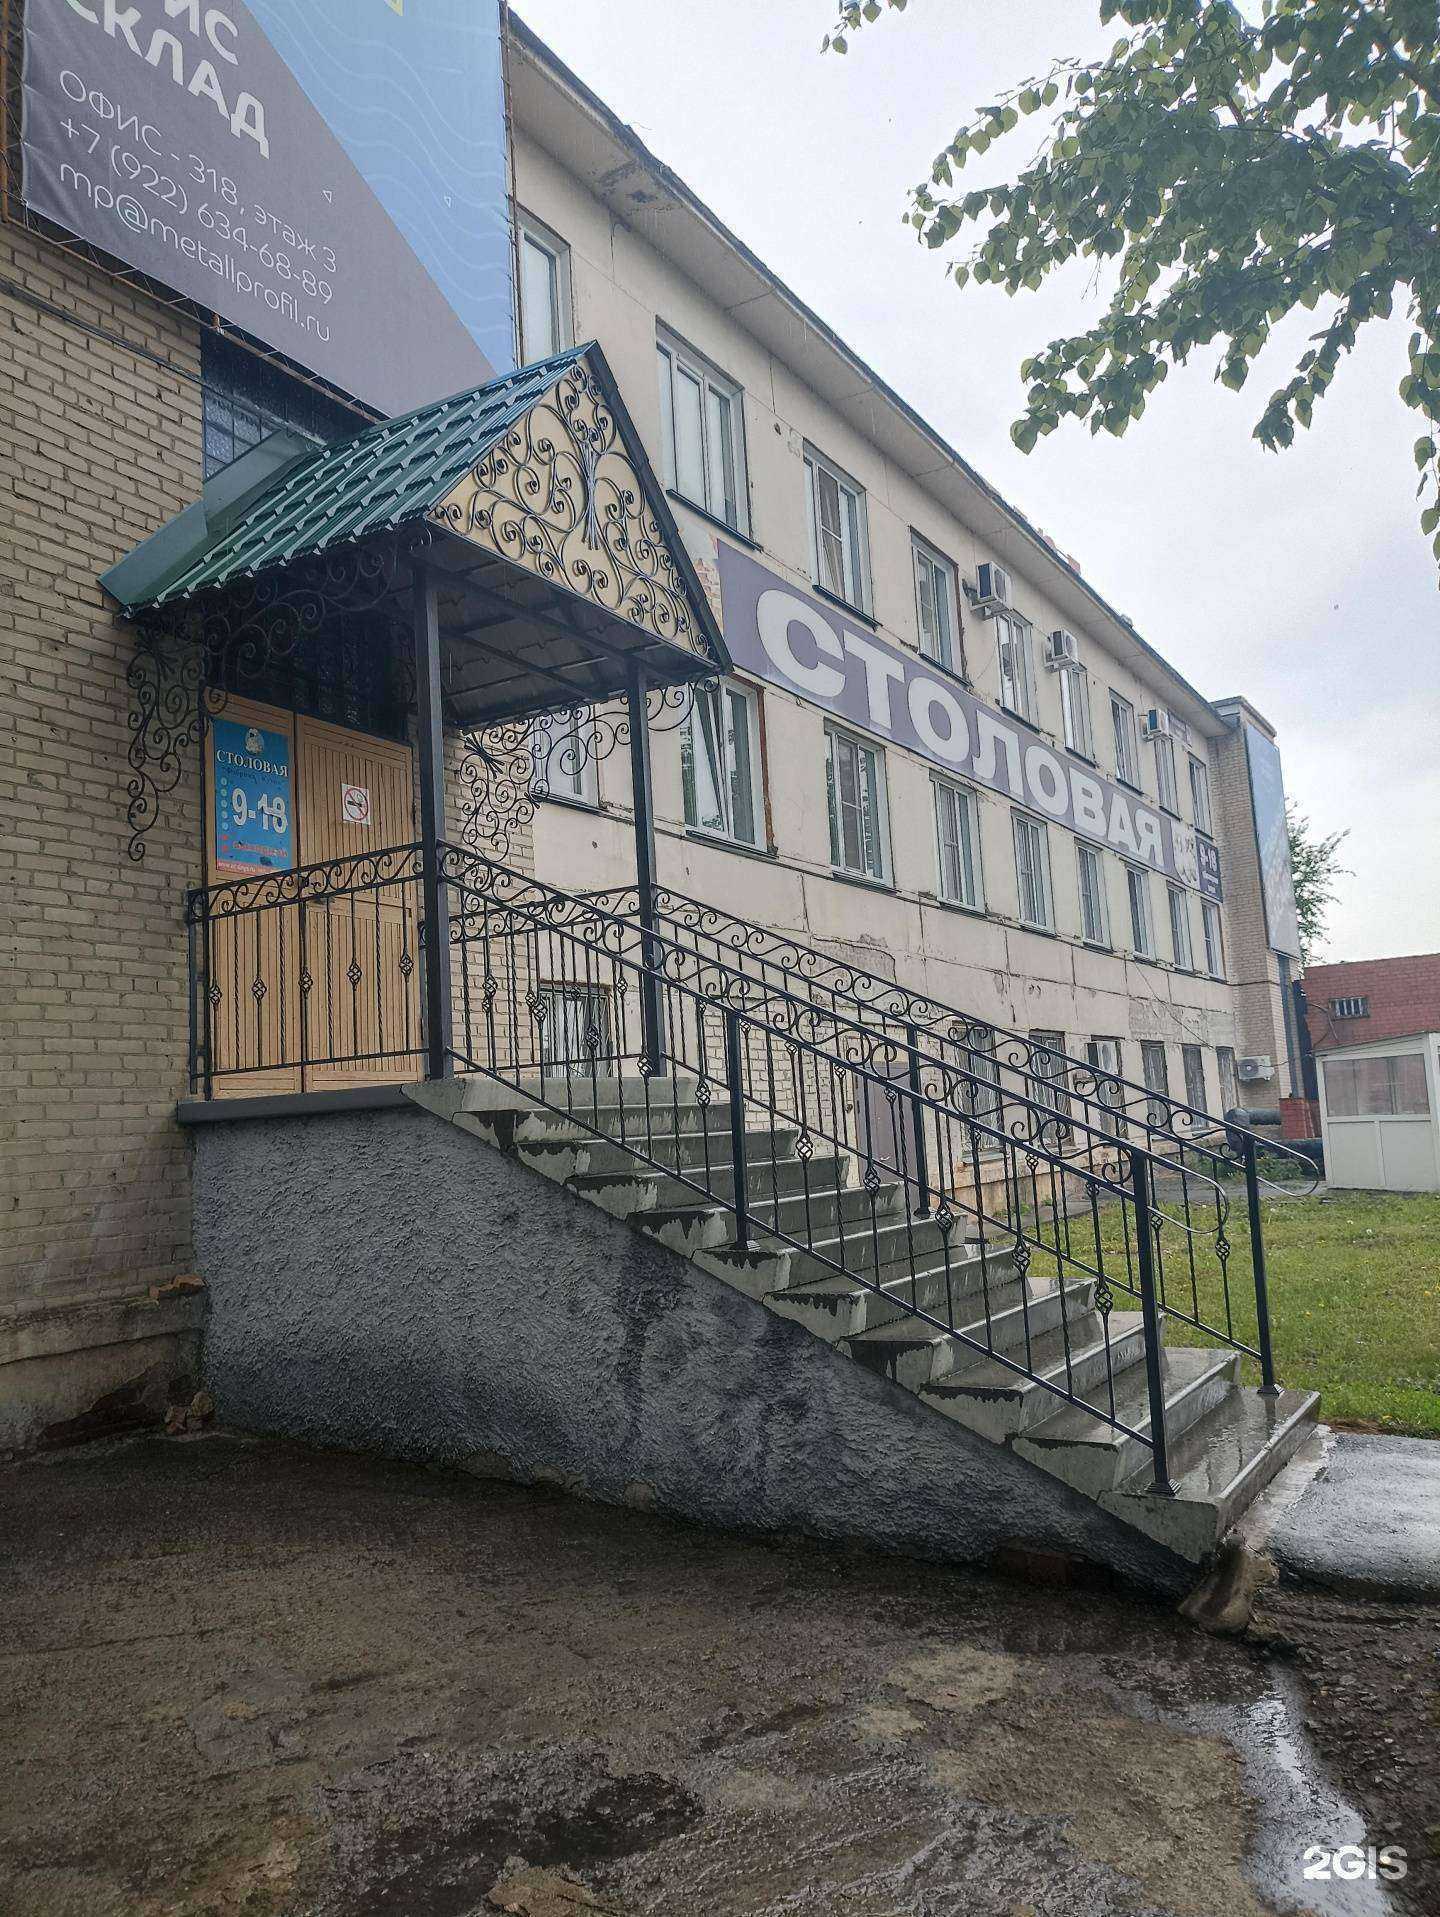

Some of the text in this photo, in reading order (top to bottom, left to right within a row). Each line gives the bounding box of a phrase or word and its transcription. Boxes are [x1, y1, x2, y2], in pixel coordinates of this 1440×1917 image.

[60, 70, 162, 156] ОФИС
[253, 203, 317, 261] этаж
[322, 245, 337, 273] 3
[60, 118, 333, 304] +7 (922) 634-68-89
[60, 163, 331, 342] mp@metallprofil.ru
[216, 749, 289, 777] СТОЛОВАЯ
[756, 589, 1165, 870] СТОЛОВАЯ
